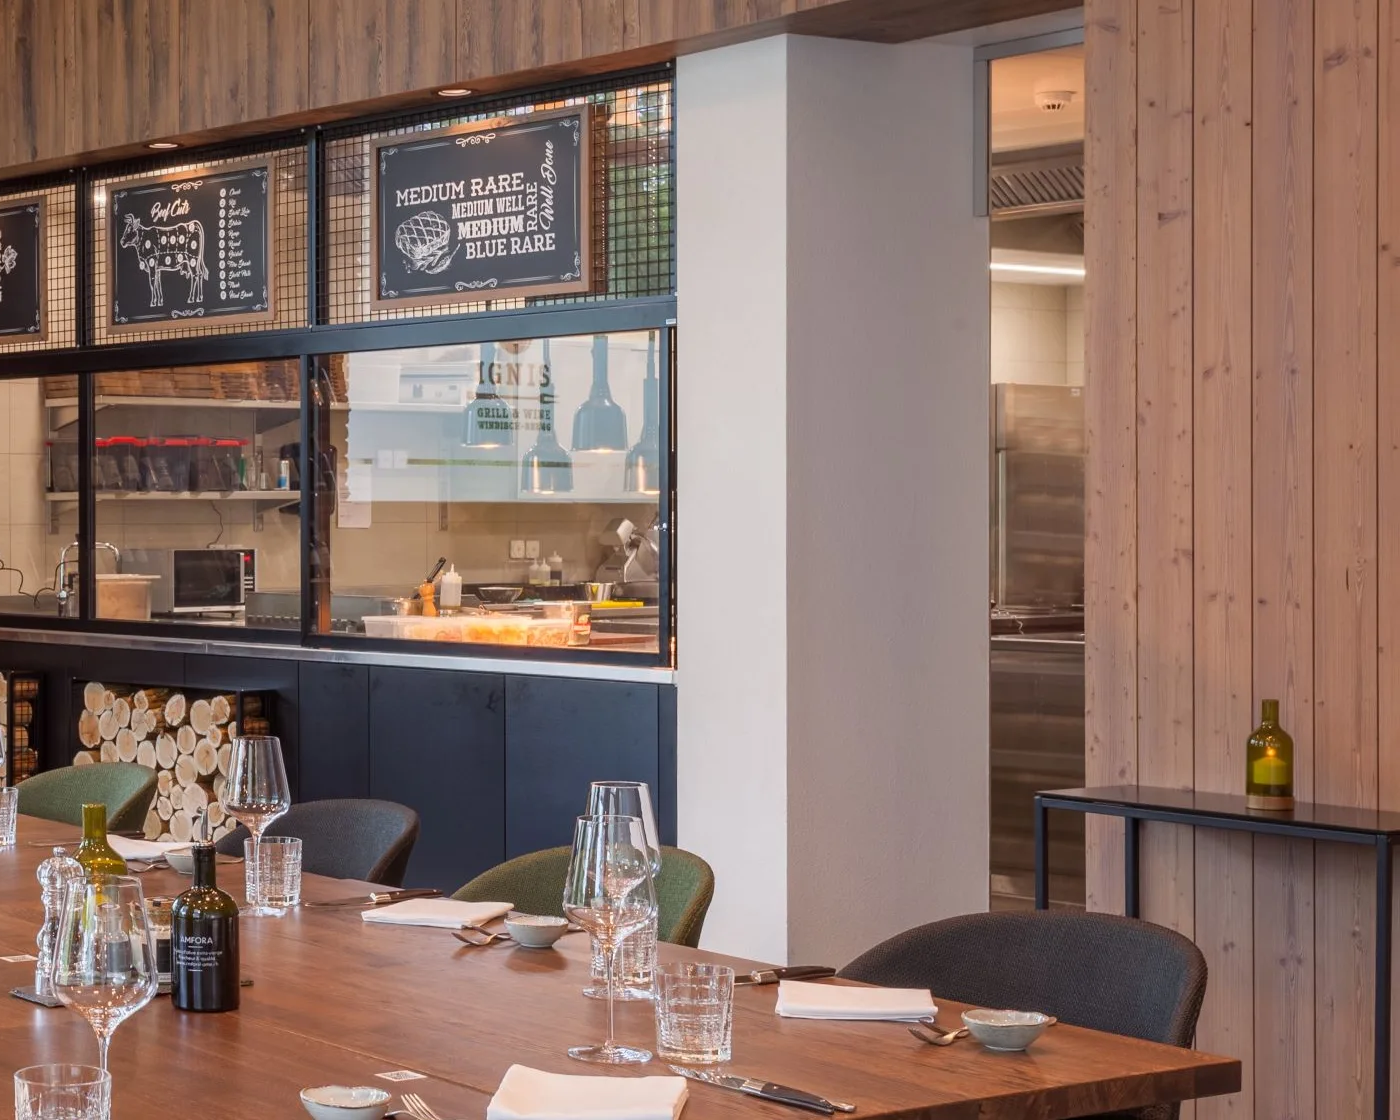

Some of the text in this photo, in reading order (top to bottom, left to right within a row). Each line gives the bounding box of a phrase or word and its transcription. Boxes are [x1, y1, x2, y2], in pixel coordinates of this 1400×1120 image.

[396, 172, 525, 207] MEDIUM RARE
[539, 139, 558, 231] Well Done
[151, 198, 191, 222] Beef Cuts
[452, 194, 525, 219] MEDIUM WELL
[526, 181, 538, 232] RARE
[457, 214, 525, 240] MEDIUM
[466, 233, 556, 260] BLUE RARE
[478, 361, 551, 388] IGNIS
[477, 407, 509, 419] GRILL
[180, 935, 214, 944] AMFORA
